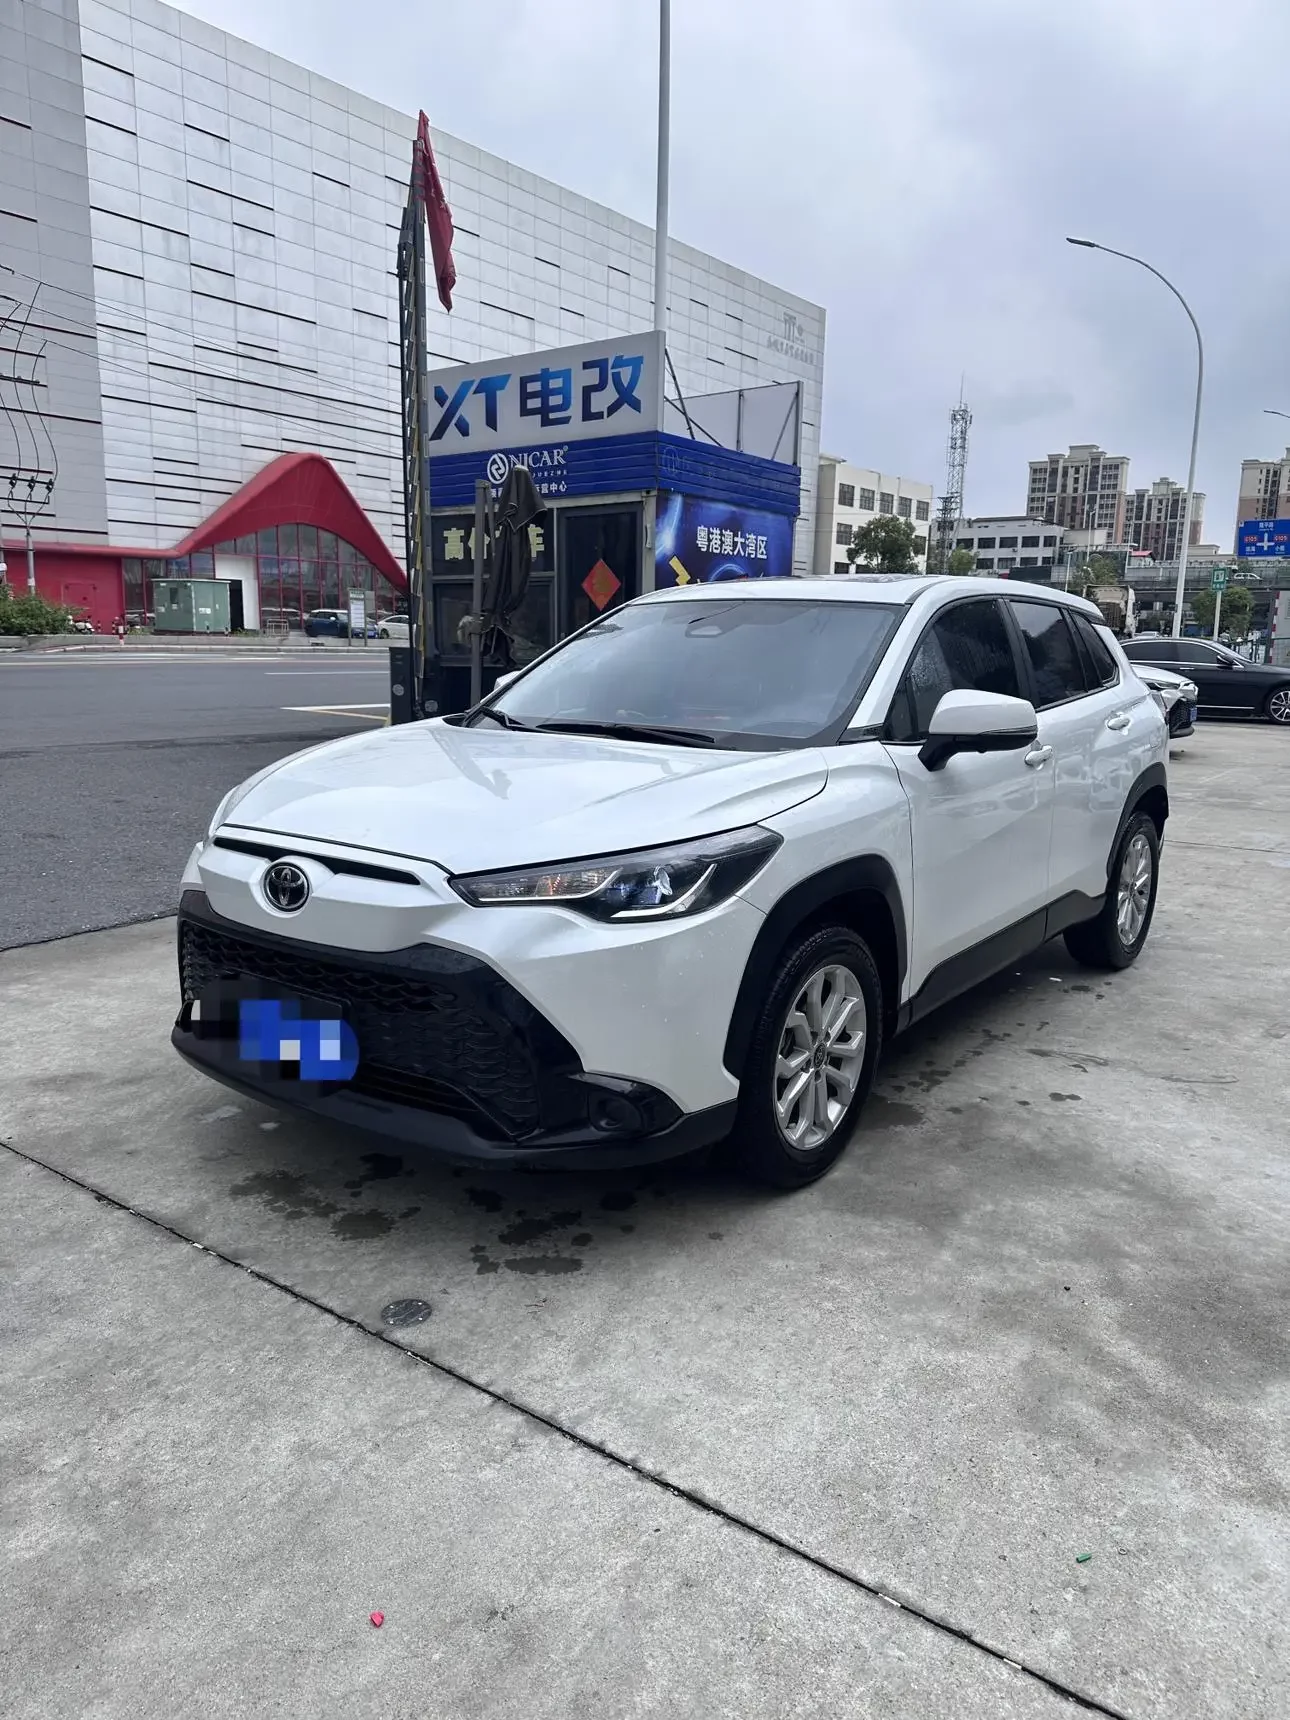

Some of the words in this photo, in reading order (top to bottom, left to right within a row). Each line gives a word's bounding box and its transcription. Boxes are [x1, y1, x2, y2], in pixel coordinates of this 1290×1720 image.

[696, 526, 768, 559] 粤港澳大湾区
